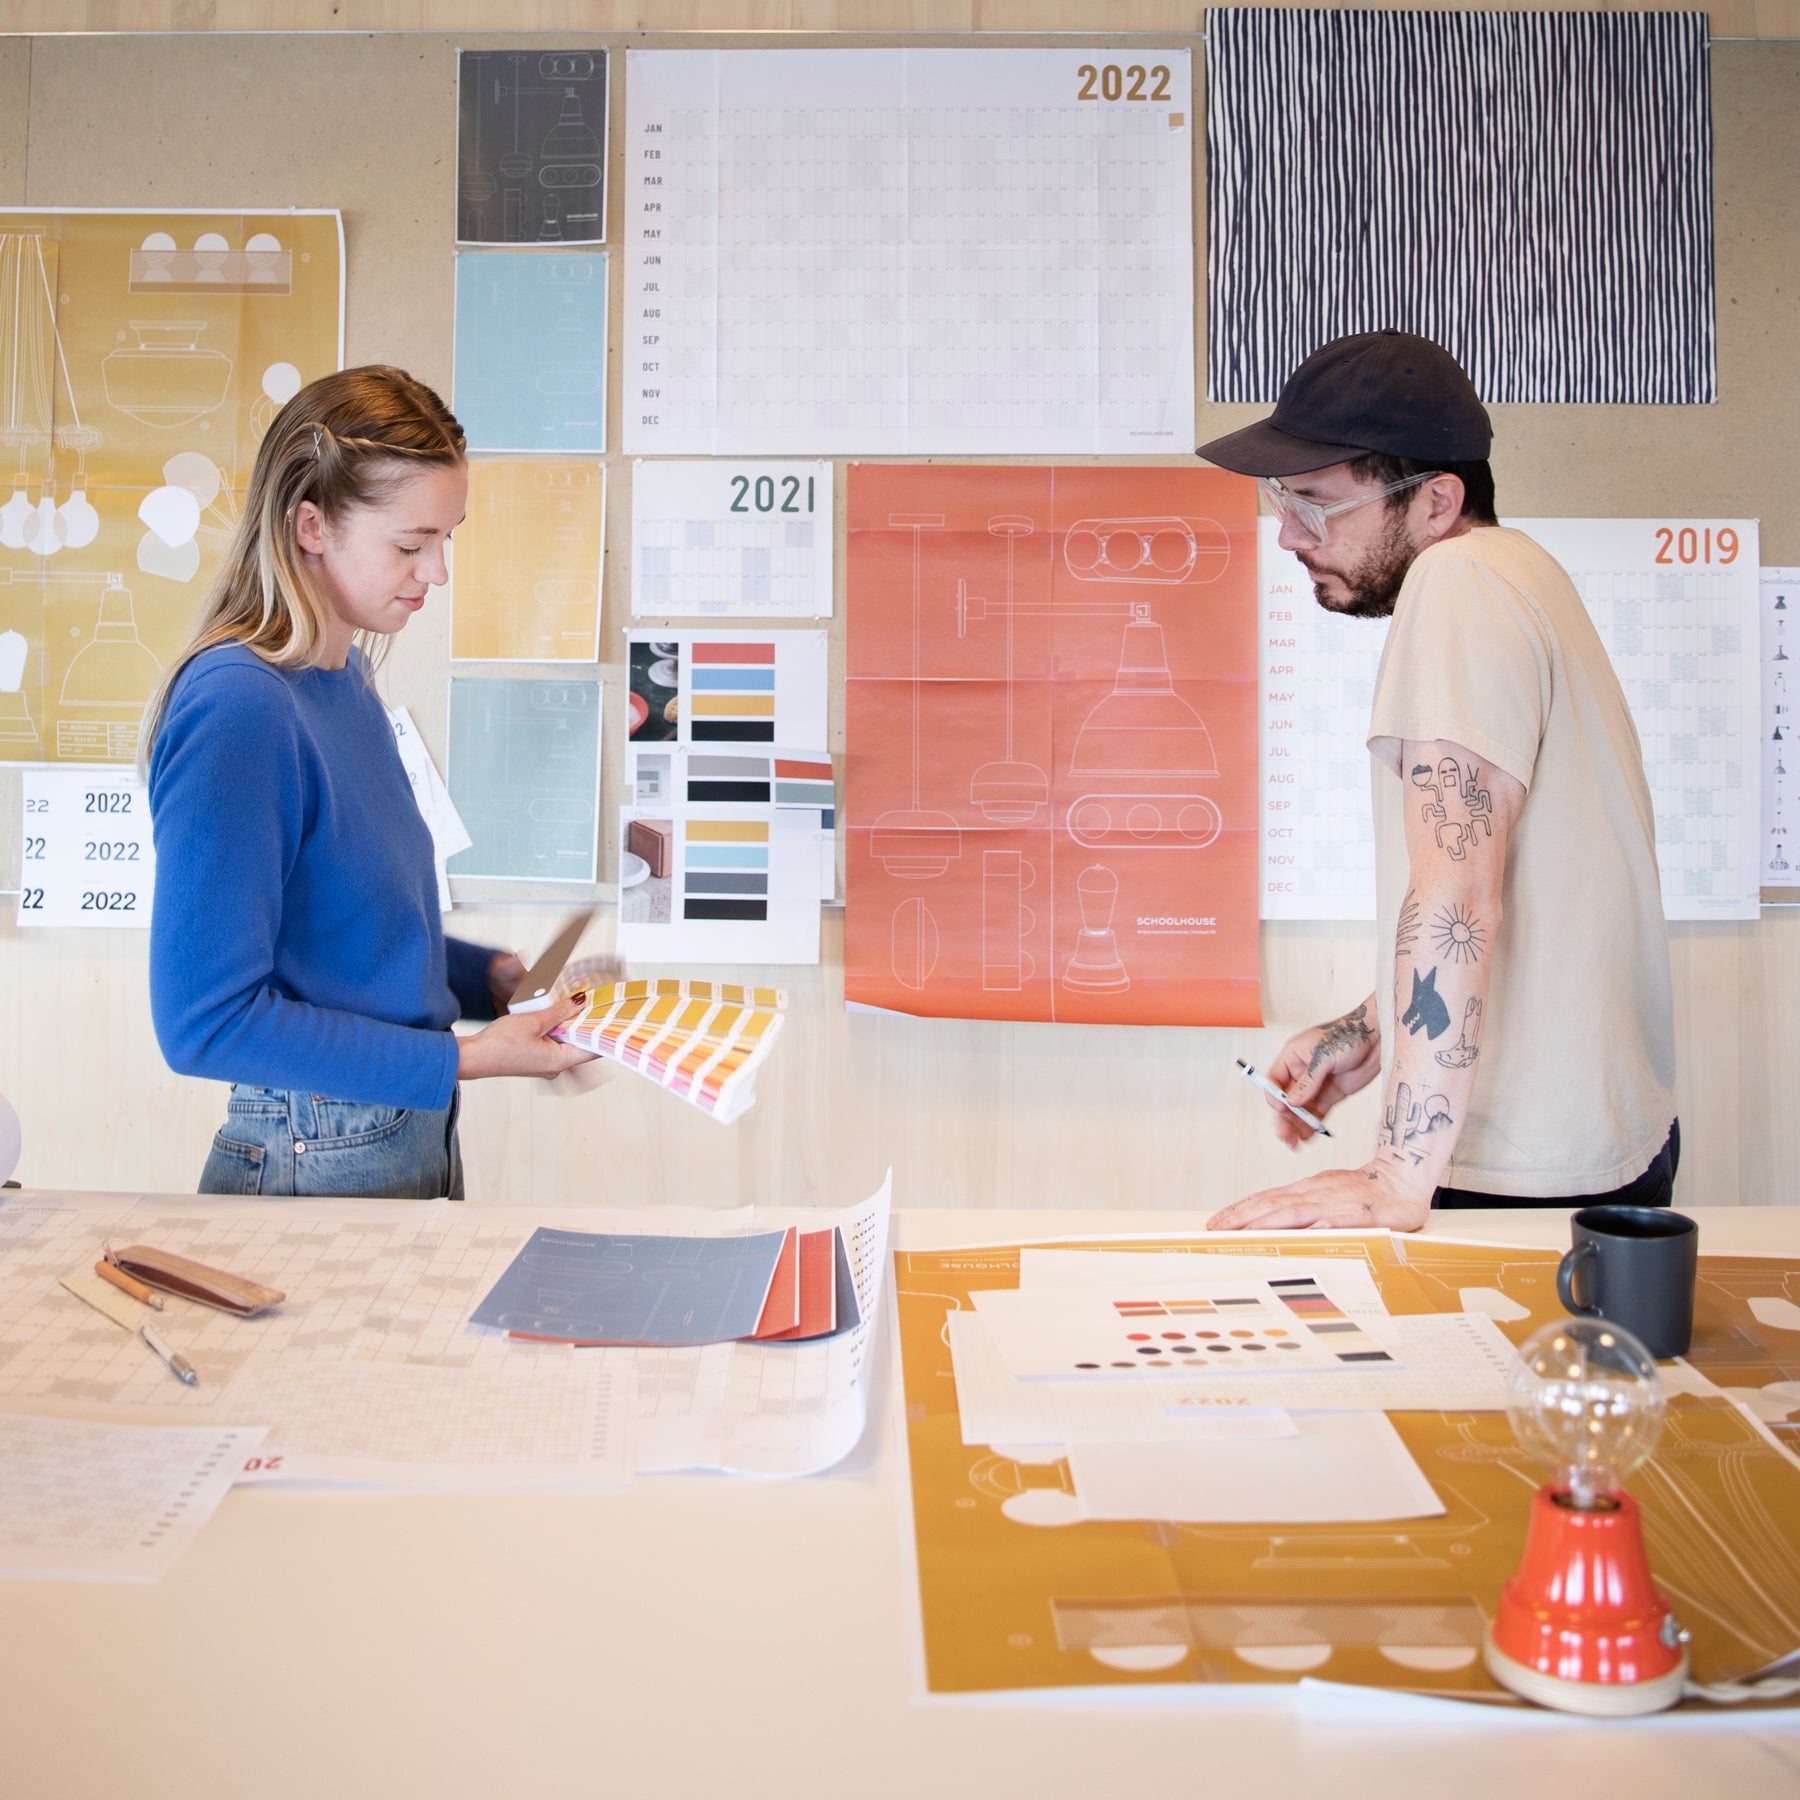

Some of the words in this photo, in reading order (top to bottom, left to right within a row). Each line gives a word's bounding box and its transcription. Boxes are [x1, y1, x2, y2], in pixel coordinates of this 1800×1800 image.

[1077, 64, 1171, 101] 2022
[644, 124, 662, 133] JAN
[644, 150, 661, 159] FEB
[643, 177, 663, 185] MAR
[643, 203, 661, 212] APR
[643, 229, 661, 238] MAY
[643, 256, 661, 265] JUN
[642, 282, 660, 291] JUL
[642, 309, 661, 318] AUG
[642, 335, 660, 345] SEP
[642, 362, 660, 371] OCT
[642, 389, 661, 398] NOV
[642, 416, 659, 425] DEC
[730, 475, 814, 513] 2021
[1655, 527, 1738, 564] 2019
[1268, 585, 1293, 594] JAN
[1268, 611, 1292, 621] FEB
[1268, 639, 1296, 648] MAR
[1268, 666, 1294, 675] APR
[1268, 693, 1294, 702] MAY
[1268, 720, 1292, 729] JUN
[1268, 747, 1291, 757] JUL
[1268, 774, 1295, 783] AUG
[85, 792, 132, 813] 2022
[1268, 801, 1291, 811] SEP
[1267, 828, 1294, 838] OCT
[84, 841, 140, 861] 2022
[1267, 855, 1295, 865] NOV
[1267, 882, 1293, 892] DEC
[81, 891, 136, 910] 2022
[1136, 917, 1216, 926] SCHOOLHOUSE
